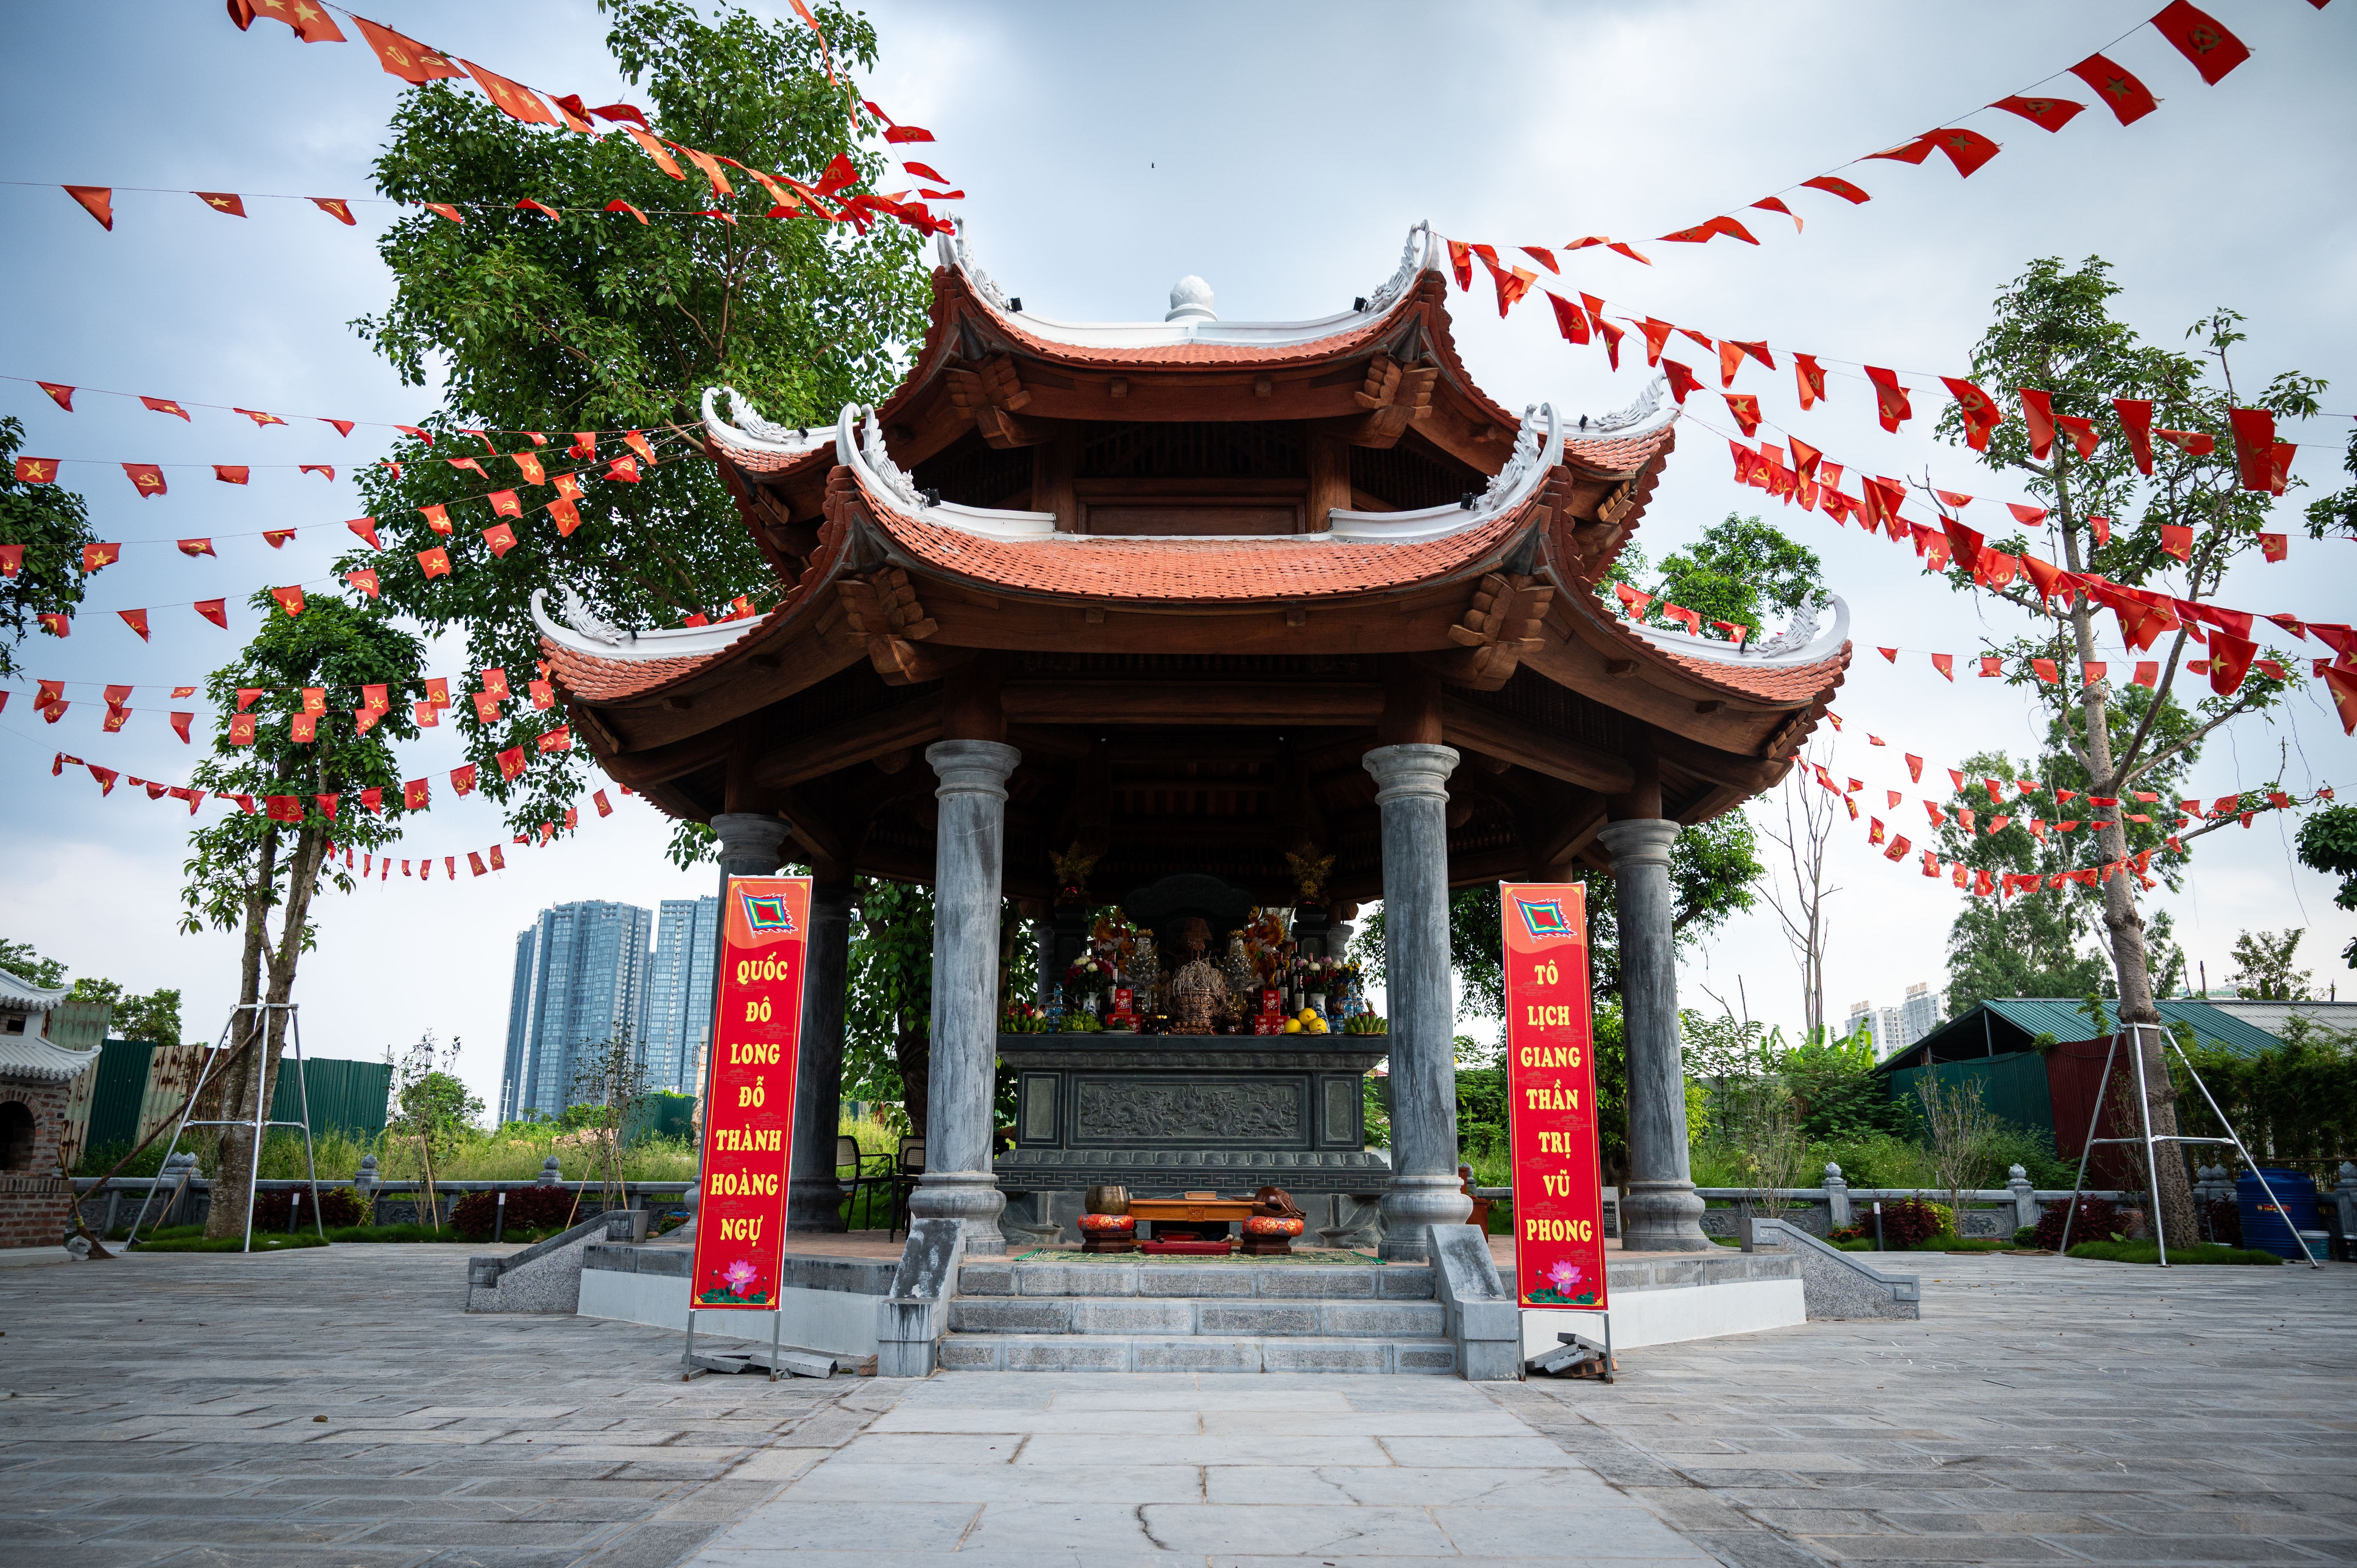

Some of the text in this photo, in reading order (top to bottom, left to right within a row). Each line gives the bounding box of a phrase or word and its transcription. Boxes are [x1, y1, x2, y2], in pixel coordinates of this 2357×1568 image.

[737, 952, 788, 985] QUỐC
[1534, 959, 1558, 985] TÔ
[746, 996, 772, 1022] ĐÔ
[1527, 1005, 1570, 1031] LỊCH
[730, 1044, 780, 1065] LONG
[1520, 1047, 1581, 1067] GIANG
[739, 1075, 765, 1107] ĐỖ
[1526, 1079, 1578, 1110] THẦN
[716, 1123, 782, 1151] THÀNH
[1538, 1132, 1571, 1159] TRỊ
[710, 1167, 778, 1195] HOÀNG
[1542, 1169, 1570, 1197] VŨ
[720, 1215, 763, 1247] NGỰ
[1526, 1219, 1592, 1242] PHONG
